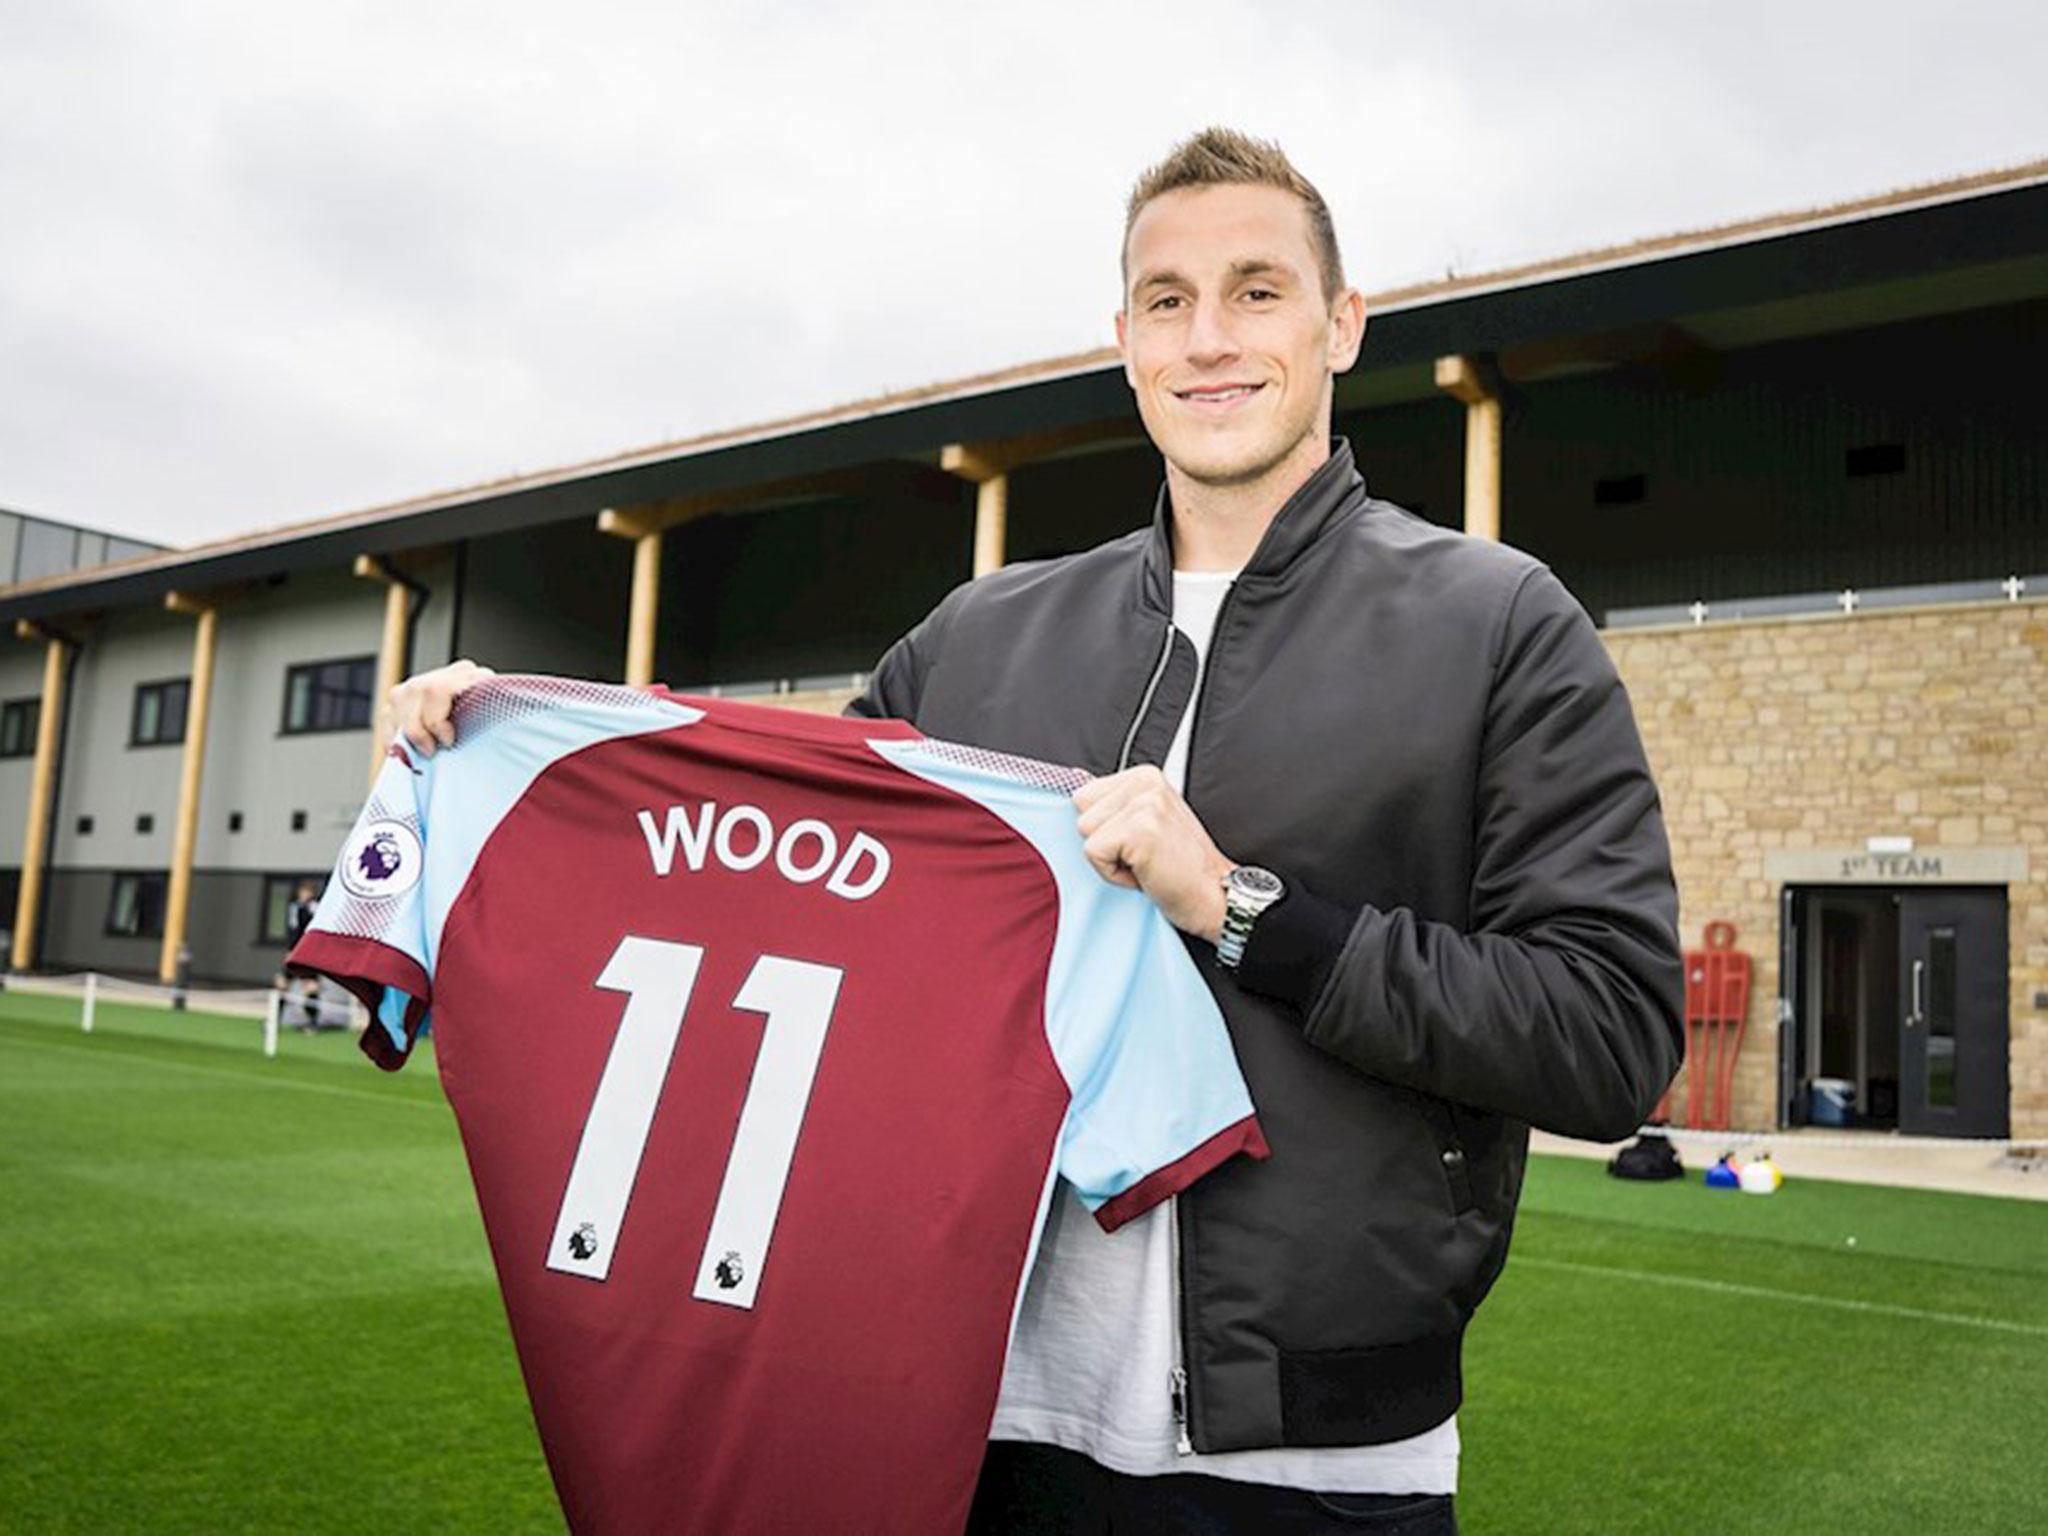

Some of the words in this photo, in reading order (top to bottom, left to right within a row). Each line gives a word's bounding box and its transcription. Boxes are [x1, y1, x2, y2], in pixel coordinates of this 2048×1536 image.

[637, 801, 892, 901] WOOD
[1872, 858, 1942, 877] TEAM
[545, 934, 845, 1311] 11
